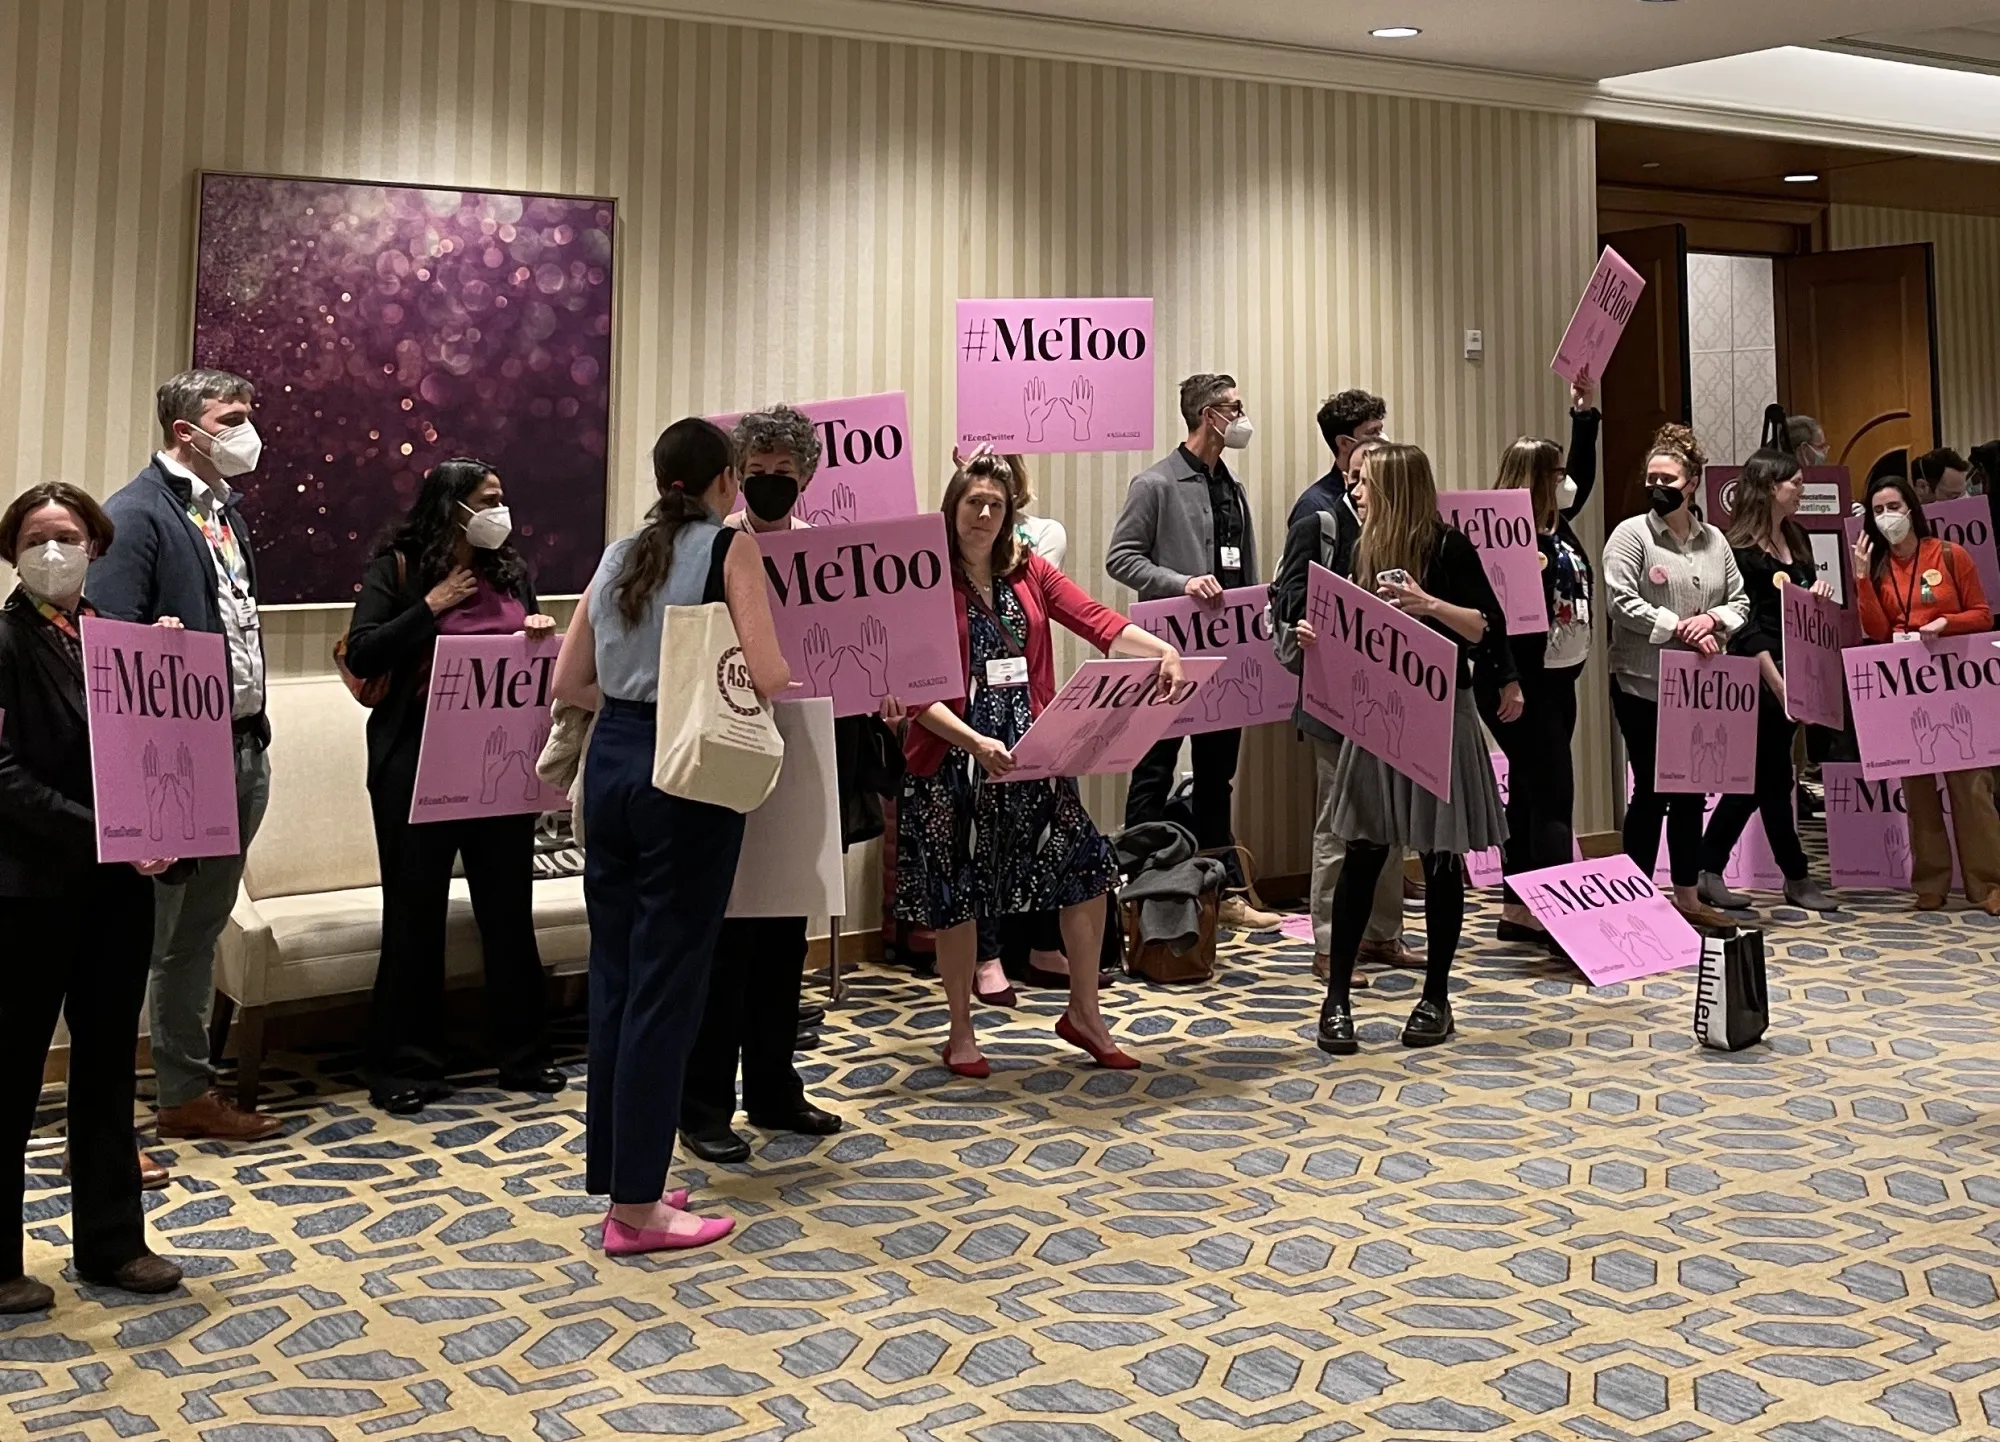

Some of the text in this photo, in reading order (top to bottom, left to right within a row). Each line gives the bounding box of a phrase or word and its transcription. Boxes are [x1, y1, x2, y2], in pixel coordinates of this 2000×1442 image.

[1591, 266, 1633, 326] #MeToo
[962, 317, 1146, 362] #MeToo
[813, 418, 903, 469] Too
[962, 432, 1015, 442] #EconTwitter
[1799, 503, 1831, 513] eetings
[1925, 517, 1987, 546] Too
[762, 541, 942, 608] MeToo
[1143, 603, 1274, 653] #MeTo
[1310, 584, 1448, 702] #MeToo
[1785, 599, 1841, 652] #MeToo
[93, 645, 225, 722] #MeToo
[434, 656, 559, 711] #MeT
[727, 663, 755, 690] AS
[1663, 667, 1756, 713] #MeToo
[1852, 651, 2000, 701] #MeToo
[1526, 872, 1655, 920] #MeToo
